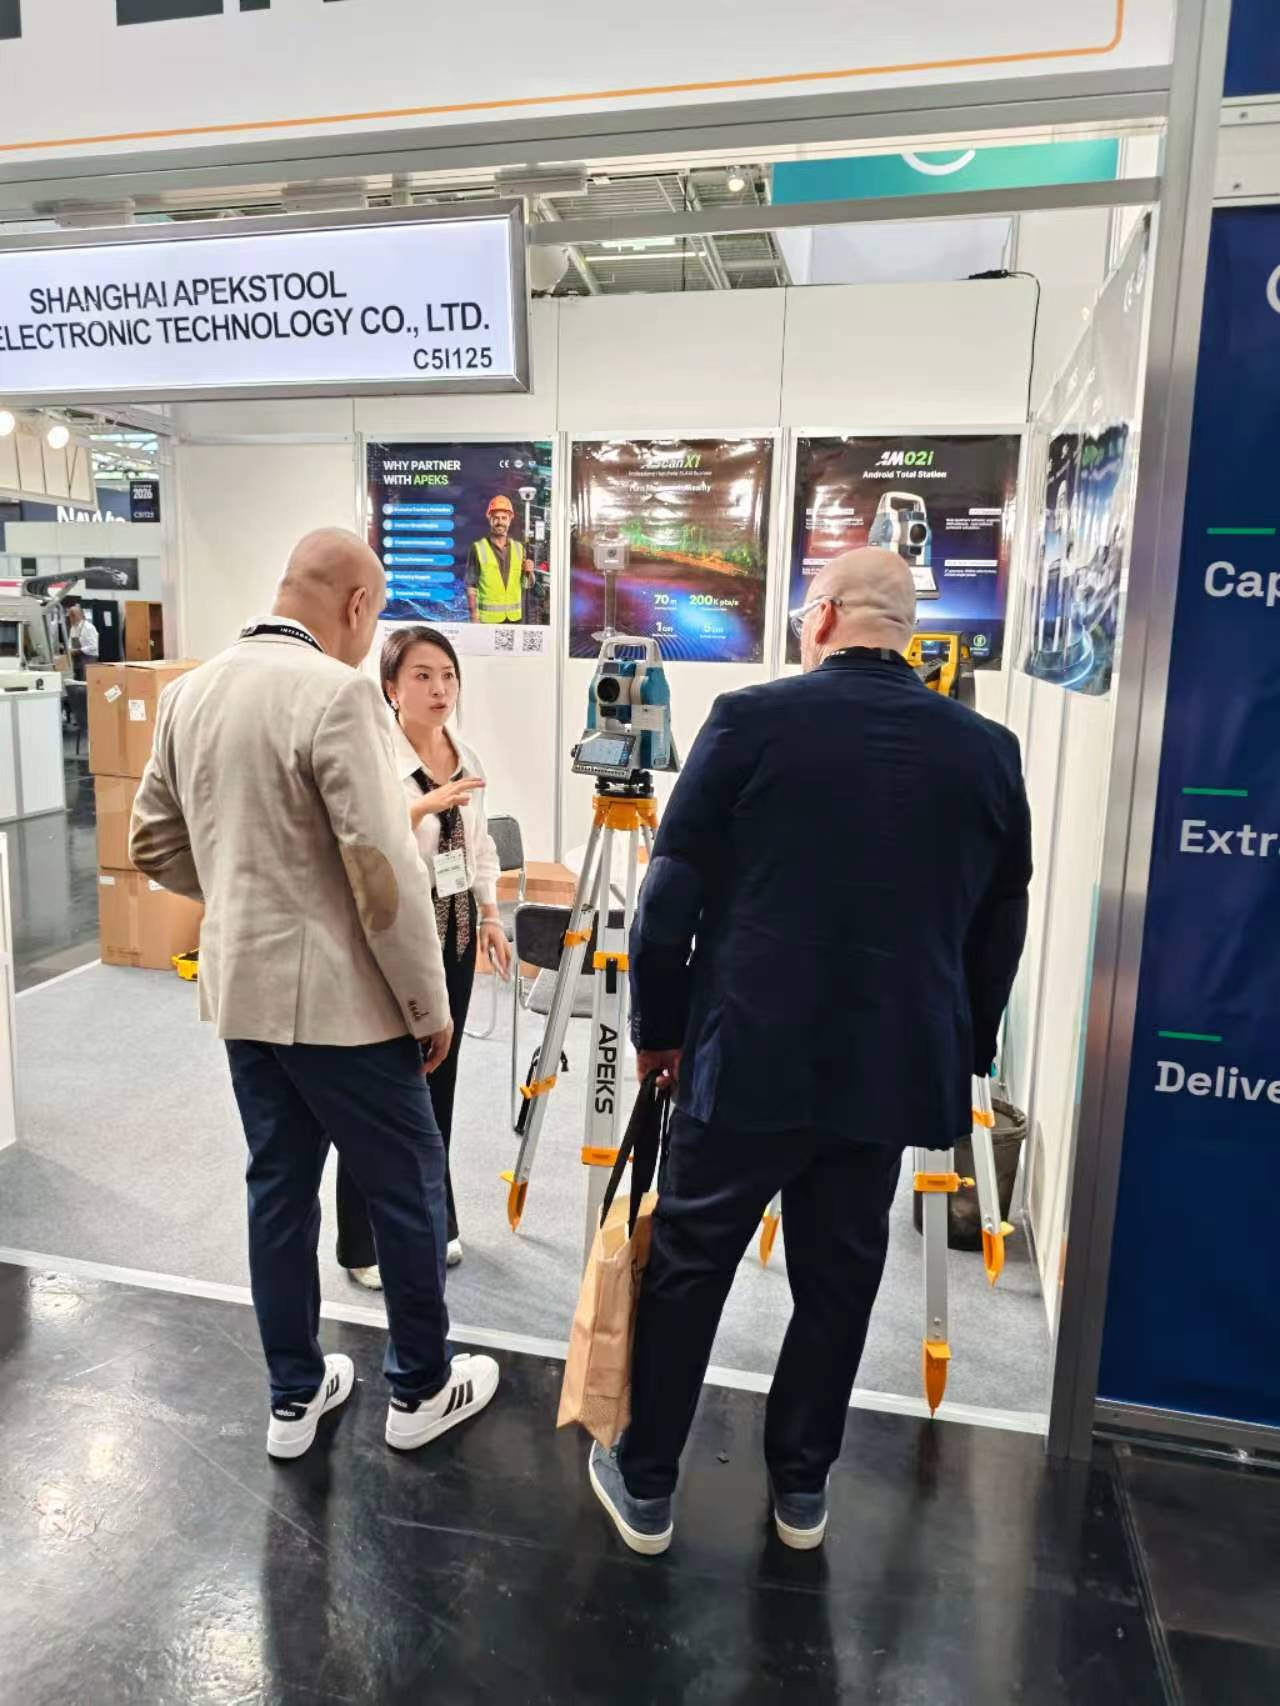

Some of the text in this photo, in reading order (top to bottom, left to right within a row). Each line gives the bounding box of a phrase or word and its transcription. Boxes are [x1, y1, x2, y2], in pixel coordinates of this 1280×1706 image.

[29, 270, 347, 315] SHANGHAI APEKSTOOL
[156, 307, 353, 344] TECHNOLOGY
[360, 305, 419, 338] CO.,
[426, 302, 490, 332] LTD.
[383, 460, 461, 471] WHY PARTNER
[383, 474, 449, 485] WITH APEKS
[862, 470, 947, 479] Android Total Station
[1179, 819, 1280, 857] Extr
[595, 1023, 618, 1114] APEKS
